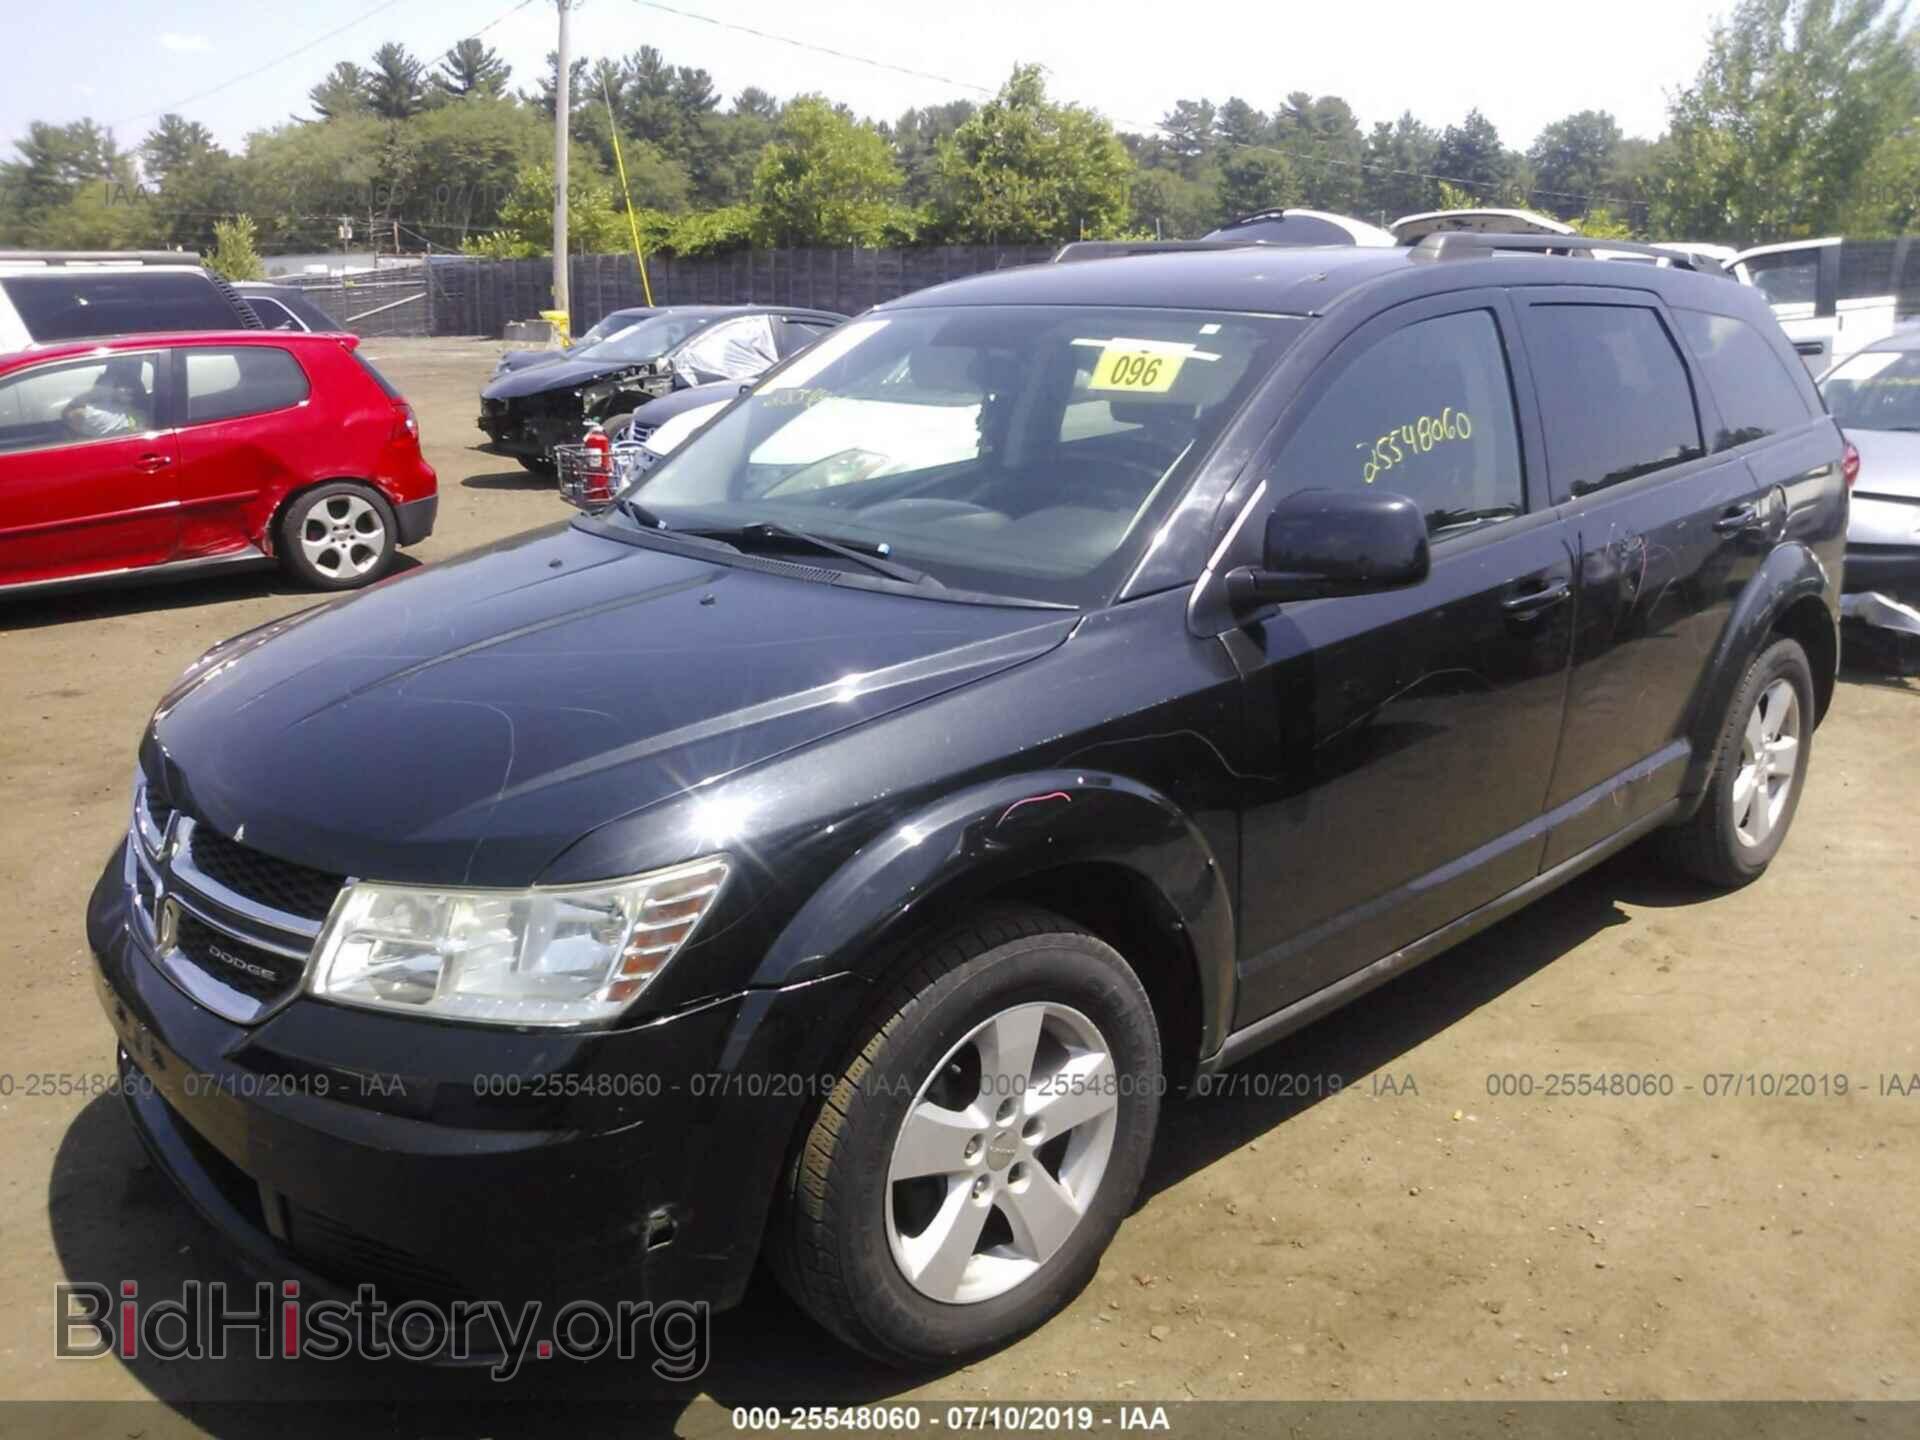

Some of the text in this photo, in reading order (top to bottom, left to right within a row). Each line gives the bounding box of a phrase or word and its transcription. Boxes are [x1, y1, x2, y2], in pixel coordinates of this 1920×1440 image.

[1110, 355, 1162, 386] 096
[1364, 407, 1471, 484] 25548060
[208, 944, 278, 983] DODGE
